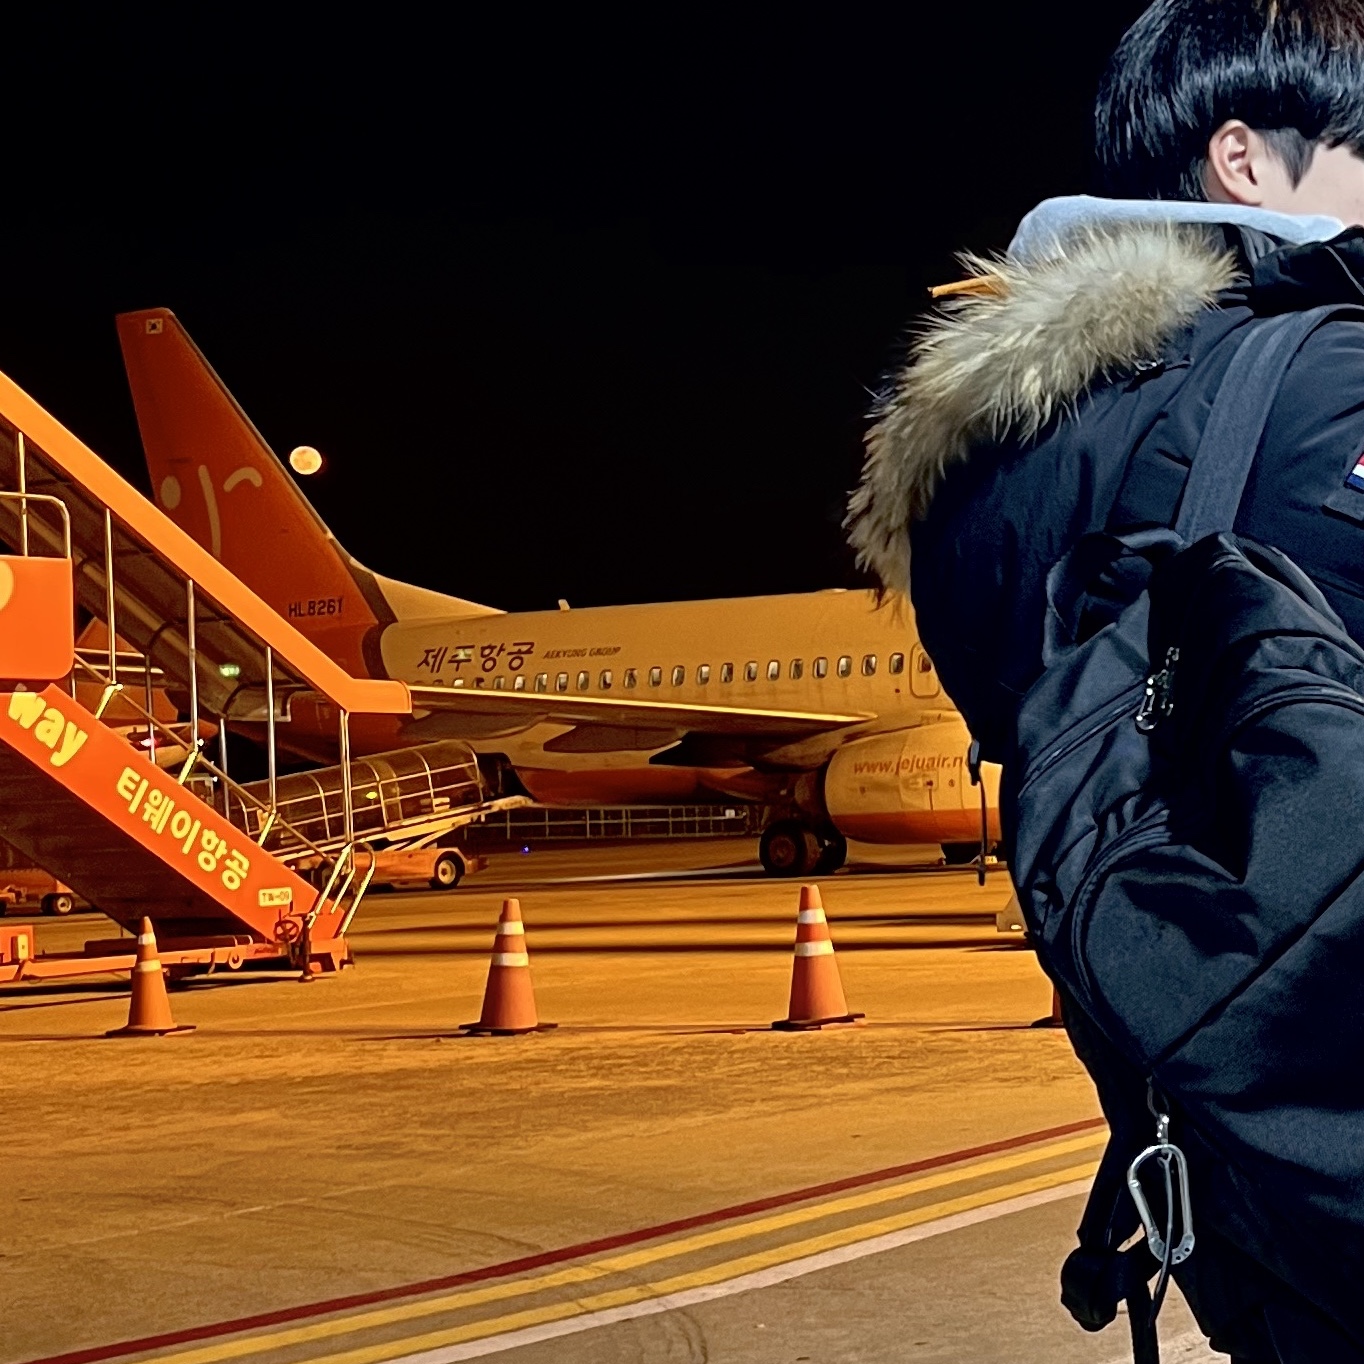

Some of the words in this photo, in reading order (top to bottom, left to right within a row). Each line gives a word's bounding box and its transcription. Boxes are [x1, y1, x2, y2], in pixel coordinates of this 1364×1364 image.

[288, 598, 343, 618] HL8261
[417, 641, 535, 673] 제주항공
[853, 752, 968, 776] www.jejuair.n
[116, 766, 250, 890] 티웨이항공
